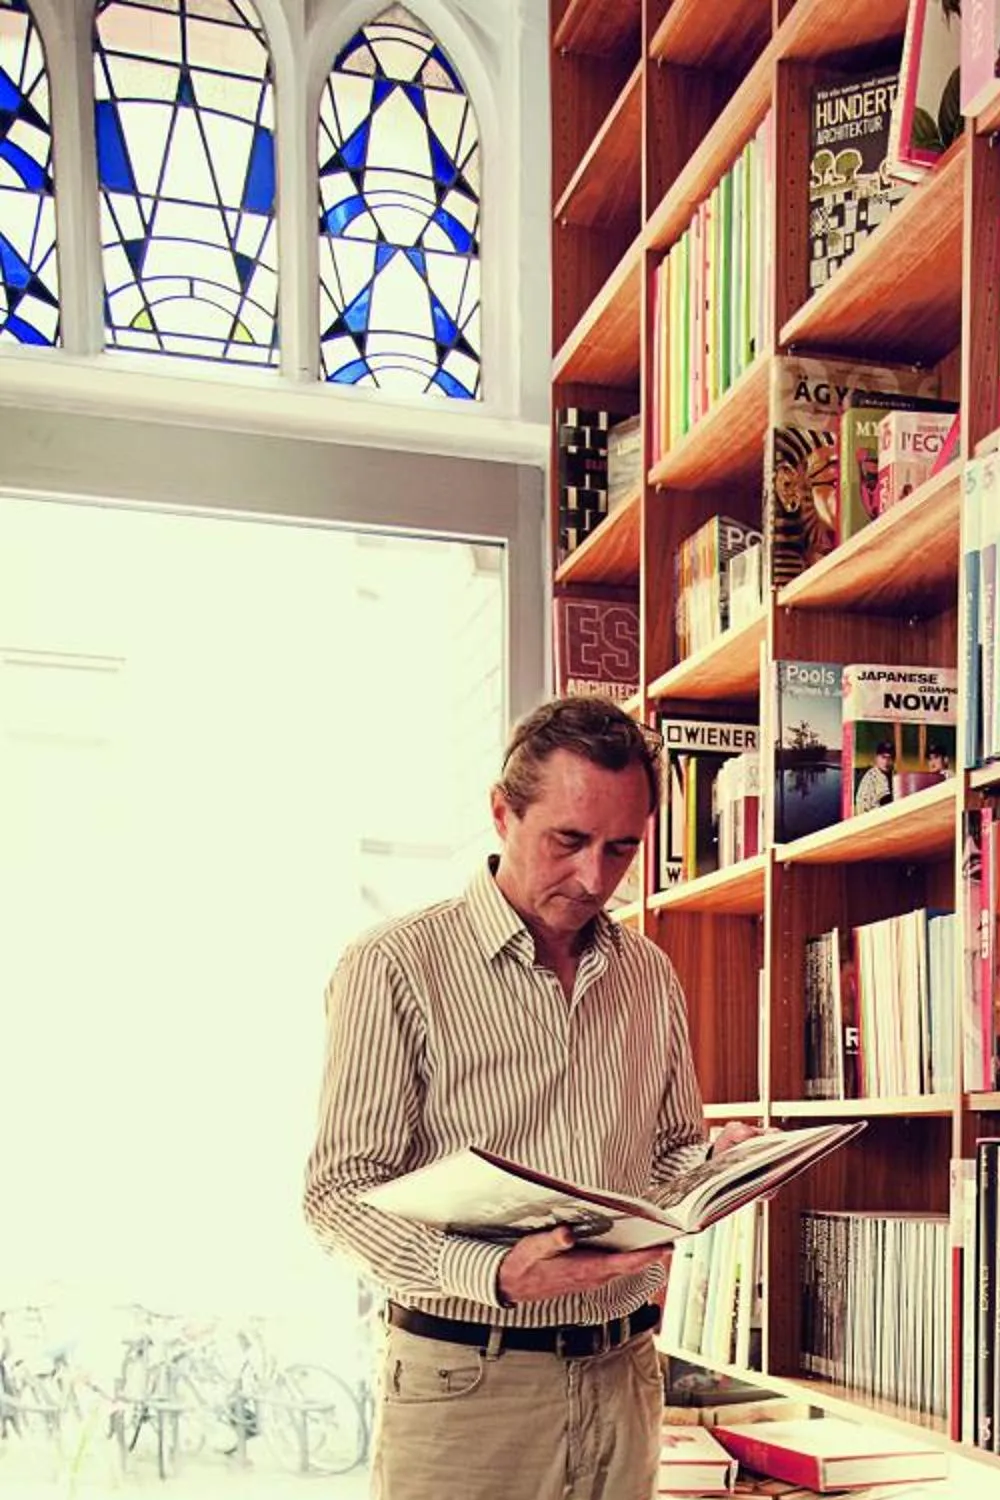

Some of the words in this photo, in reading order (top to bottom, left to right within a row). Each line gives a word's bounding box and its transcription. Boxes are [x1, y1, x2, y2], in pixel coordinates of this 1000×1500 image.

[816, 84, 898, 129] HUNDERT
[817, 116, 882, 145] ARCHITEKTUR
[786, 665, 835, 685] Pools
[857, 671, 939, 685] JAPANESE
[884, 693, 949, 713] NOW!
[684, 726, 756, 747] WIENER
